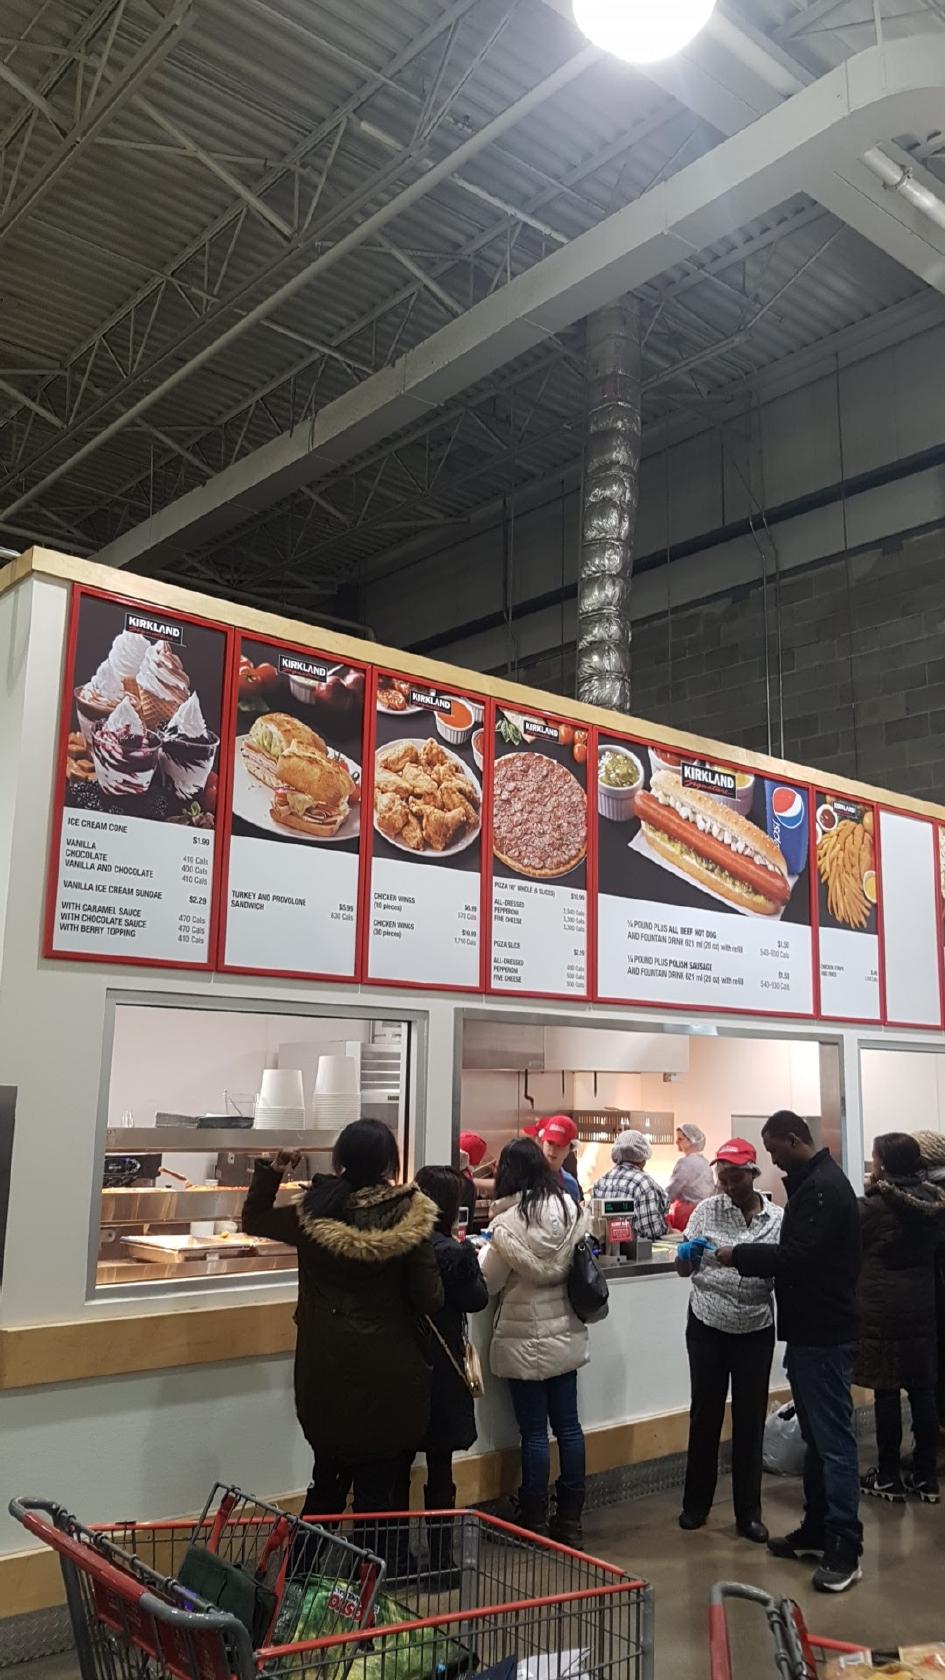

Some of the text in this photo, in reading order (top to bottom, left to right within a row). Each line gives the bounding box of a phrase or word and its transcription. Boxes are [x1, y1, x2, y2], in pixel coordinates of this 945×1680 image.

[128, 616, 180, 637] KIRKLAND
[282, 658, 326, 676] KIRKLAND
[412, 692, 451, 709] KIRKLAND
[525, 721, 559, 738] KIRKLAND
[684, 765, 735, 788] KIRKLAND
[68, 818, 128, 833] ICE CREAM CONE
[66, 839, 96, 849] VANILLA
[192, 836, 210, 846] $1.99
[65, 849, 108, 861] CHOCOLATE
[65, 859, 154, 878] VANILLA AND CHOCOLATE
[63, 880, 163, 899] VANILLA ICE CREAM SUNDAE
[374, 892, 396, 901] CHICKEN
[189, 895, 207, 905] $2.29
[231, 900, 265, 910] SANDWICH
[232, 890, 306, 906] TURKEY AND PROVOLONE
[494, 899, 525, 907] ALL-DRESSED
[61, 901, 142, 917] WITH CARAMEL SAUCE
[383, 903, 402, 912] pieces)
[494, 907, 519, 915] PEPPERONI
[60, 912, 147, 928] WITH CHOCOLATE SAUCE
[373, 920, 414, 930] CHICKEN WINGS
[59, 923, 136, 937] WITH BERRY TOPPING
[383, 930, 402, 939] pieces)
[634, 920, 653, 930] POUND
[654, 923, 668, 933] PLUS
[669, 926, 679, 935] ALL
[680, 927, 693, 935] BEEF
[695, 929, 705, 937] HOT
[706, 930, 717, 939] DOG
[494, 940, 520, 949] PIZZA SLICE
[627, 931, 640, 940] AND
[641, 933, 666, 944] FOUNTAIN
[668, 936, 684, 946] DRINK
[721, 943, 732, 952] with
[494, 957, 524, 966] ALL-DRESSED
[634, 956, 653, 965] POUND
[654, 958, 668, 967] PLUS
[669, 960, 688, 969] POLISH
[689, 962, 712, 971] SAUSAGE
[494, 966, 518, 974] PEPPERONI
[627, 966, 640, 975] AND
[641, 967, 667, 978] FOUNTAIN
[668, 970, 684, 980] DRINK
[721, 976, 732, 985] with
